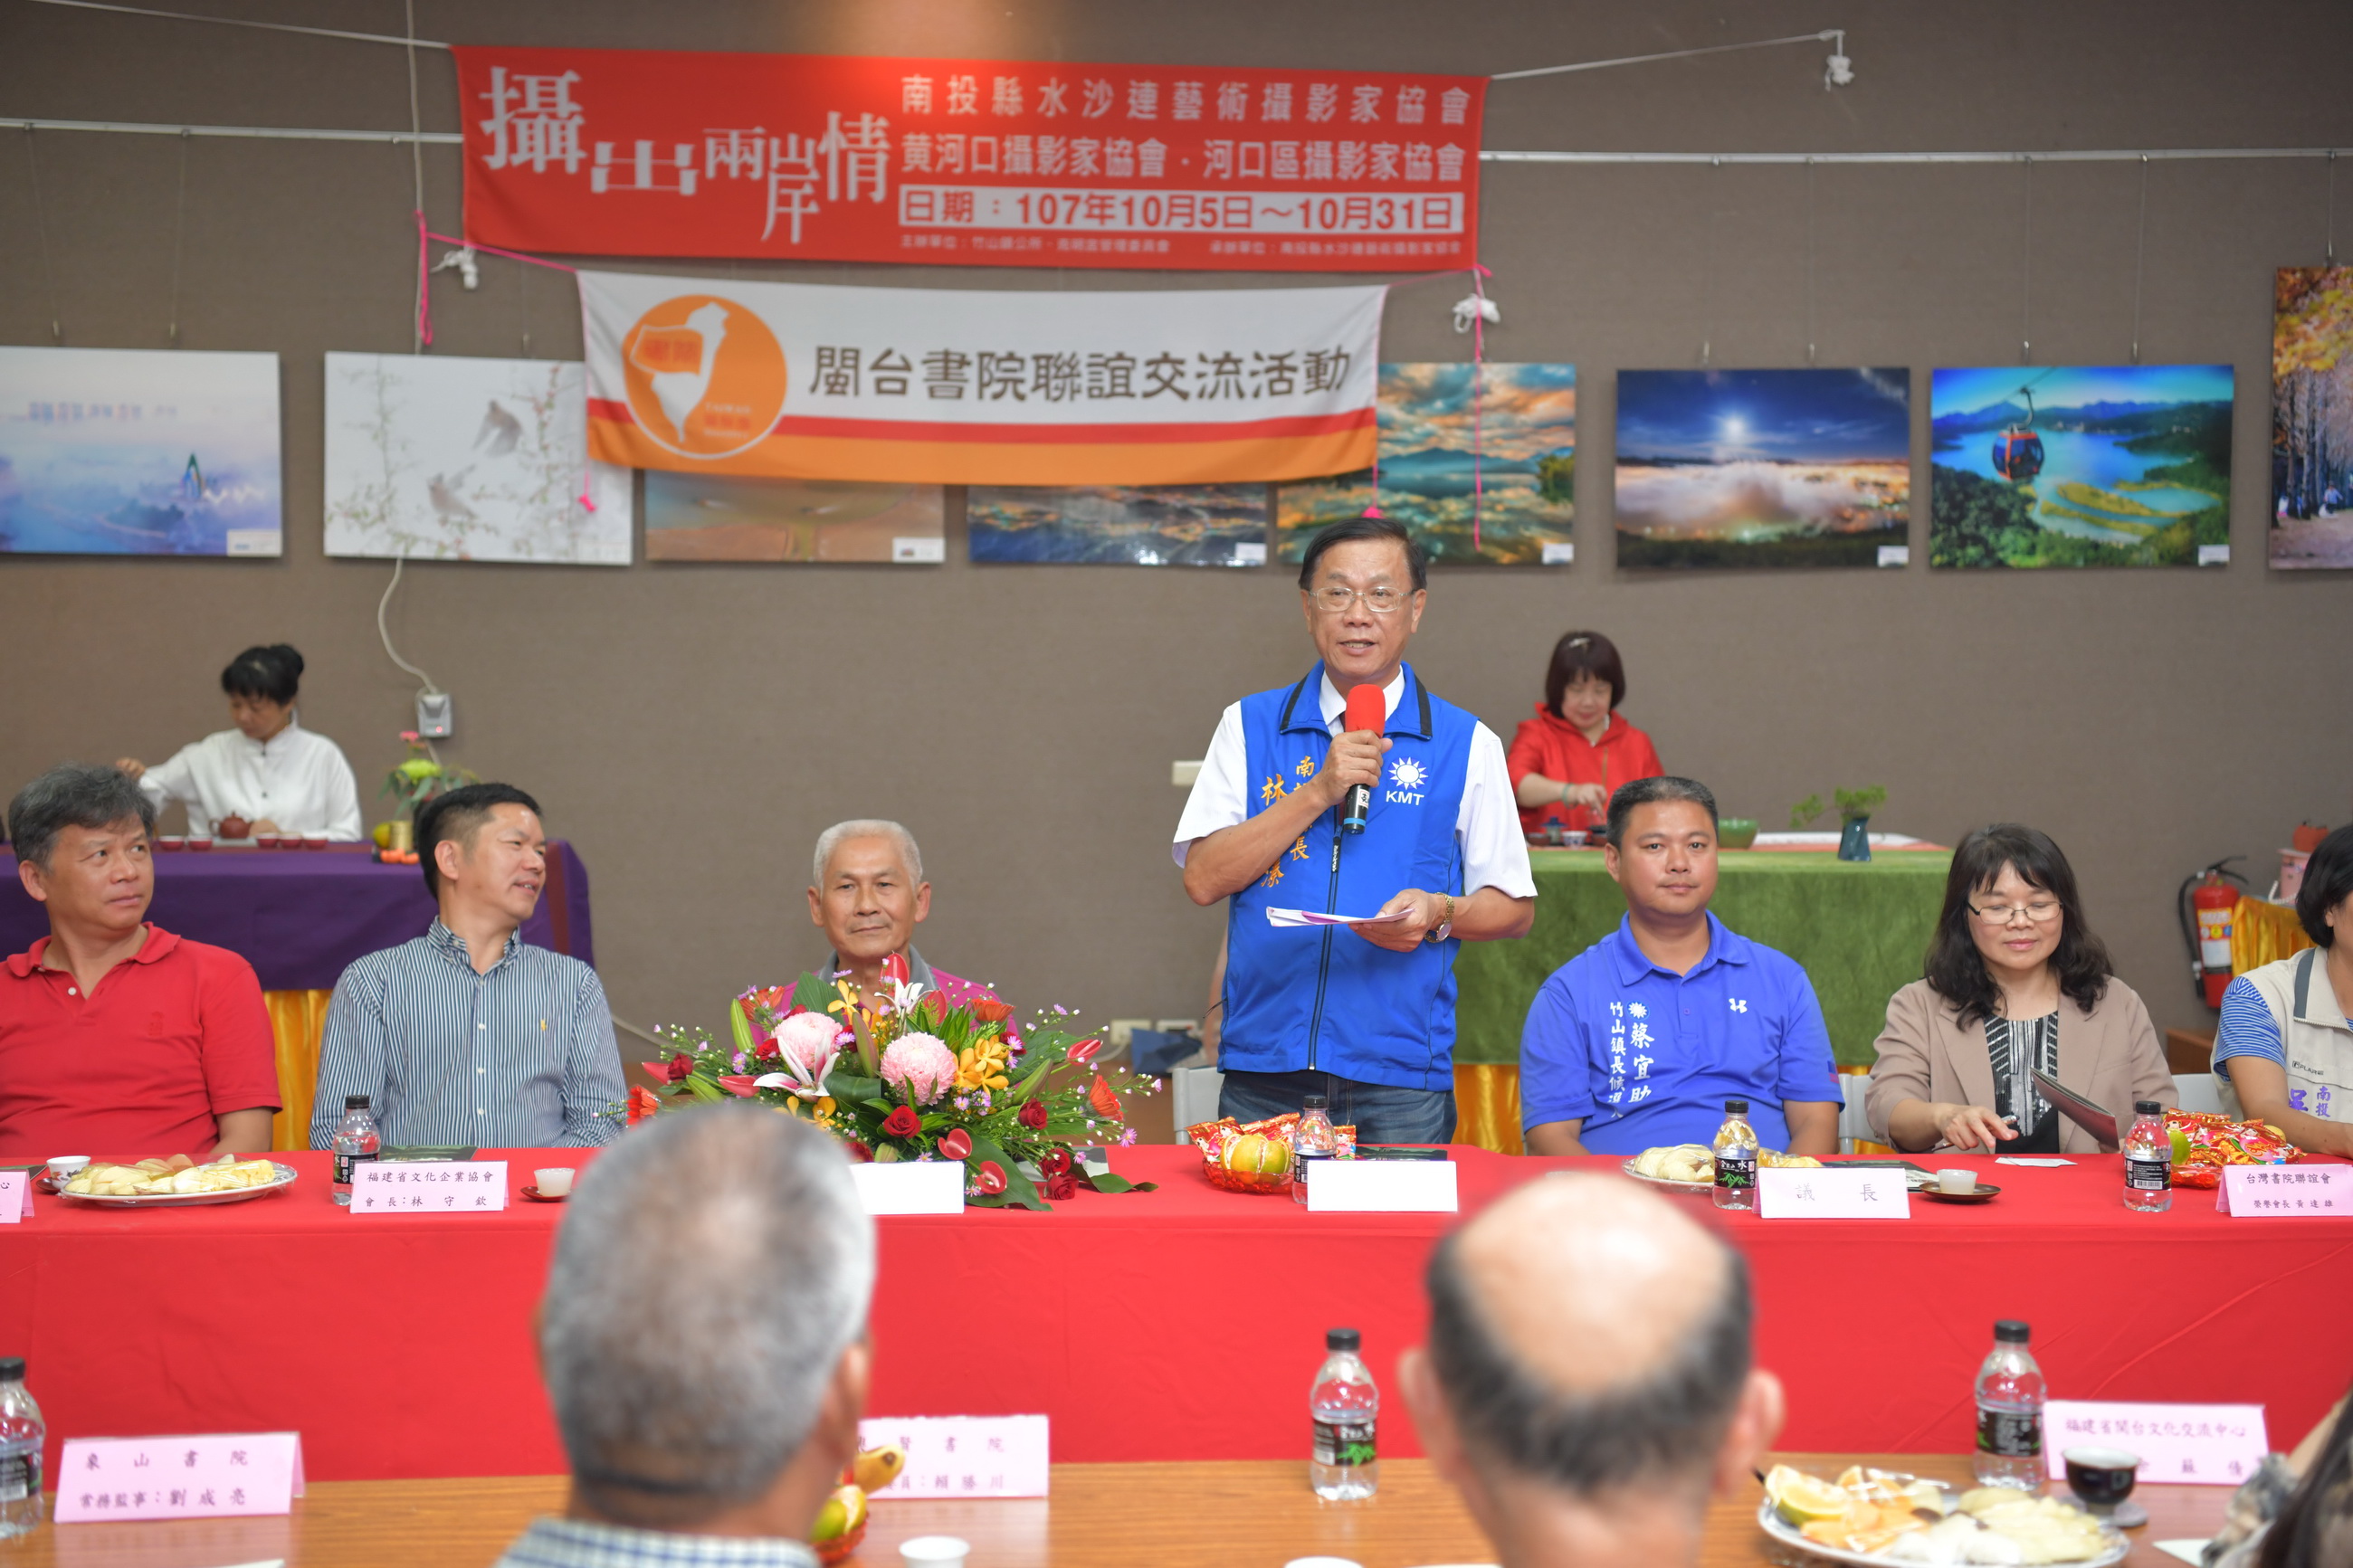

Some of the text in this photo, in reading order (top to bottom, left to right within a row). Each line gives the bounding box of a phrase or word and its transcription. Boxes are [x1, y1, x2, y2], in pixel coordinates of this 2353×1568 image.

[901, 75, 1471, 125] 南投縣水沙連藝術攝影家協會
[809, 344, 1351, 403] 閩台書院聯誼交流活動
[1386, 791, 1424, 805] KMT
[1628, 1022, 1655, 1103] 蔡宜助
[367, 1172, 493, 1183] 福建省文化企業協會
[2246, 1173, 2331, 1184] 台灣書院聯誼會
